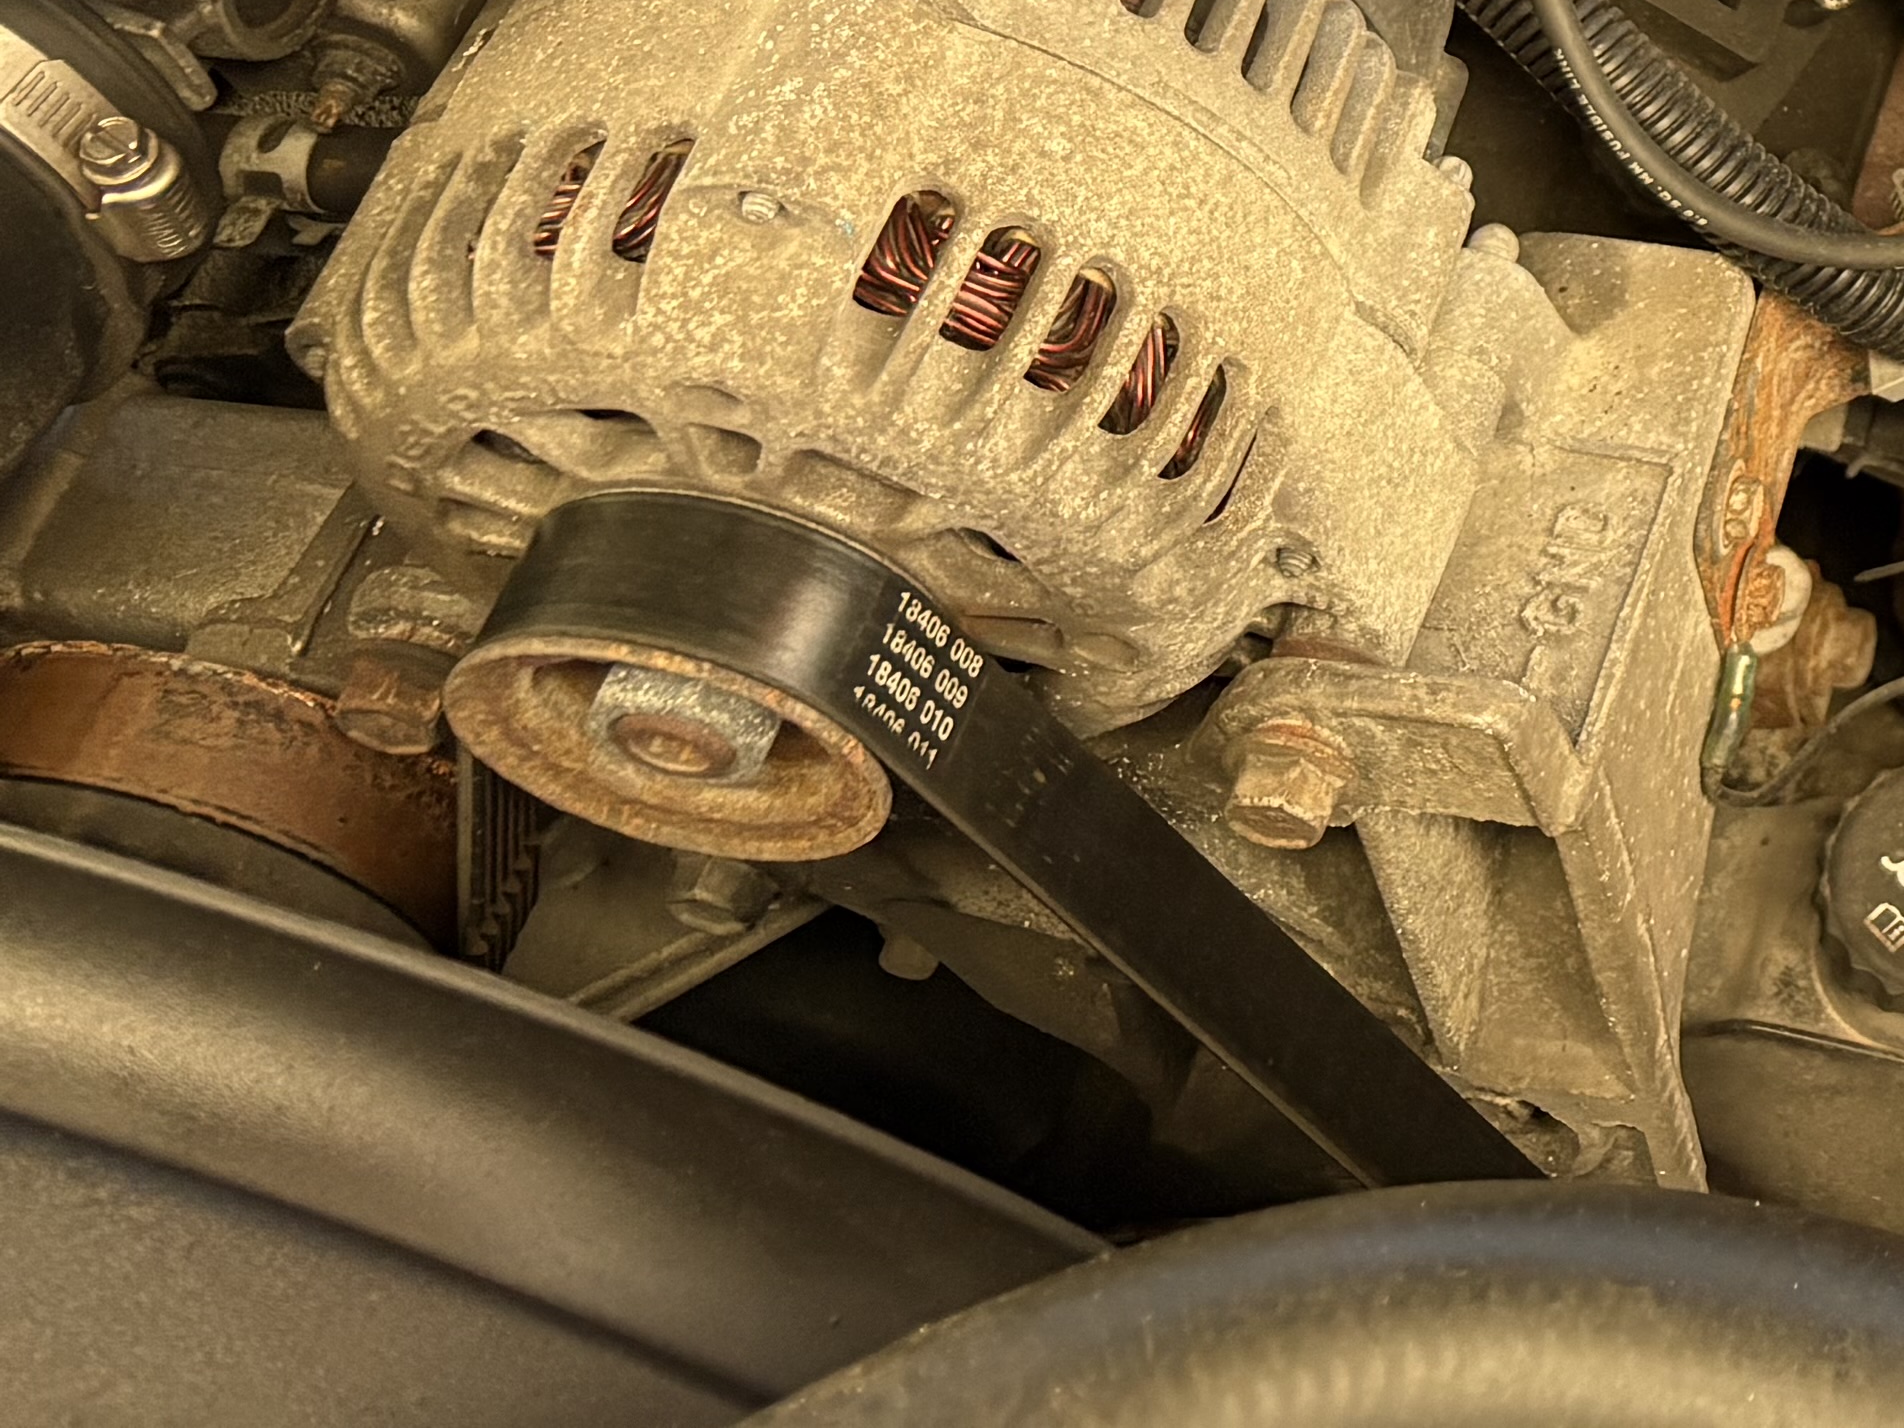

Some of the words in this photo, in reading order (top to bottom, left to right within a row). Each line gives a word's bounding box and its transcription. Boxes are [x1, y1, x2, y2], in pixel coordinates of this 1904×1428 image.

[1553, 48, 1581, 89] LINK
[1577, 94, 1631, 160] FUSIBLE
[1628, 161, 1654, 185] MM
[882, 622, 935, 679] 18406
[935, 668, 969, 709] 009
[898, 591, 951, 648] 18406
[950, 638, 984, 678] 008
[867, 653, 921, 711] 18406
[920, 700, 954, 741] 010
